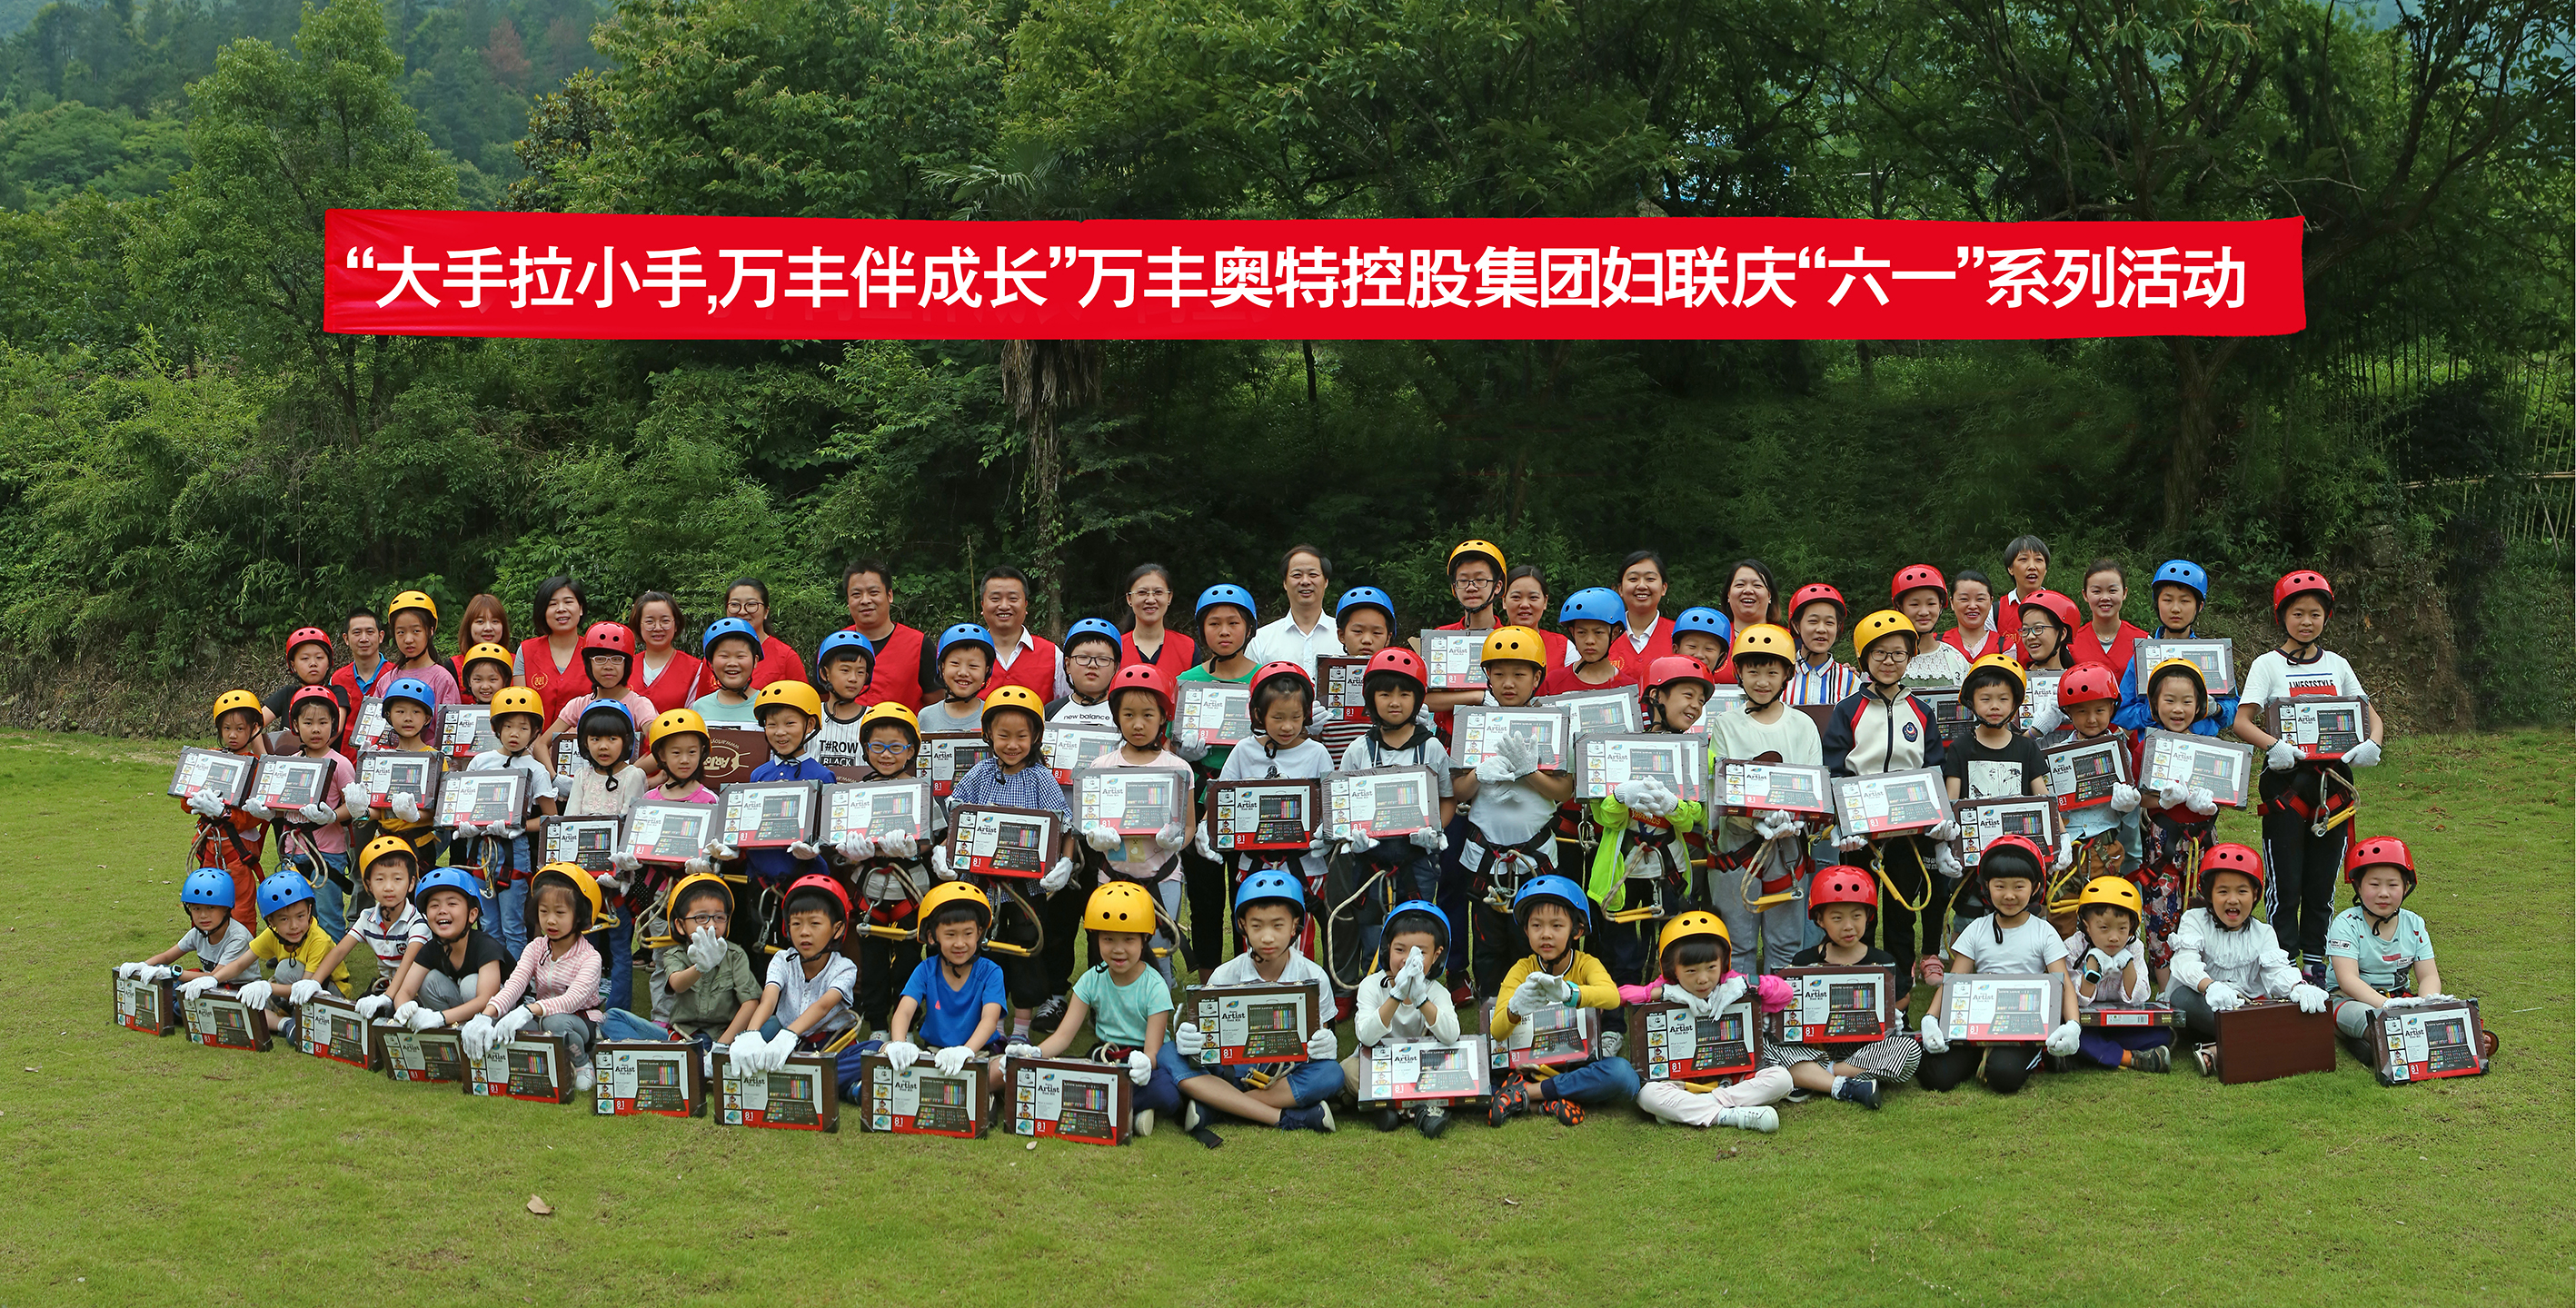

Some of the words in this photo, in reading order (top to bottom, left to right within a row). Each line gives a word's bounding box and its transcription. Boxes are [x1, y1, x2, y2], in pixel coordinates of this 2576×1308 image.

[1079, 713, 1110, 721] balance
[820, 740, 858, 754] T#ROW
[2173, 752, 2193, 761] Artist
[235, 765, 254, 774] Artist
[1864, 790, 1884, 798] Artist
[1980, 818, 2000, 827] Artist
[977, 825, 997, 833] Artist
[2405, 1028, 2424, 1036] Artist
[1038, 1085, 1059, 1093] Artist
